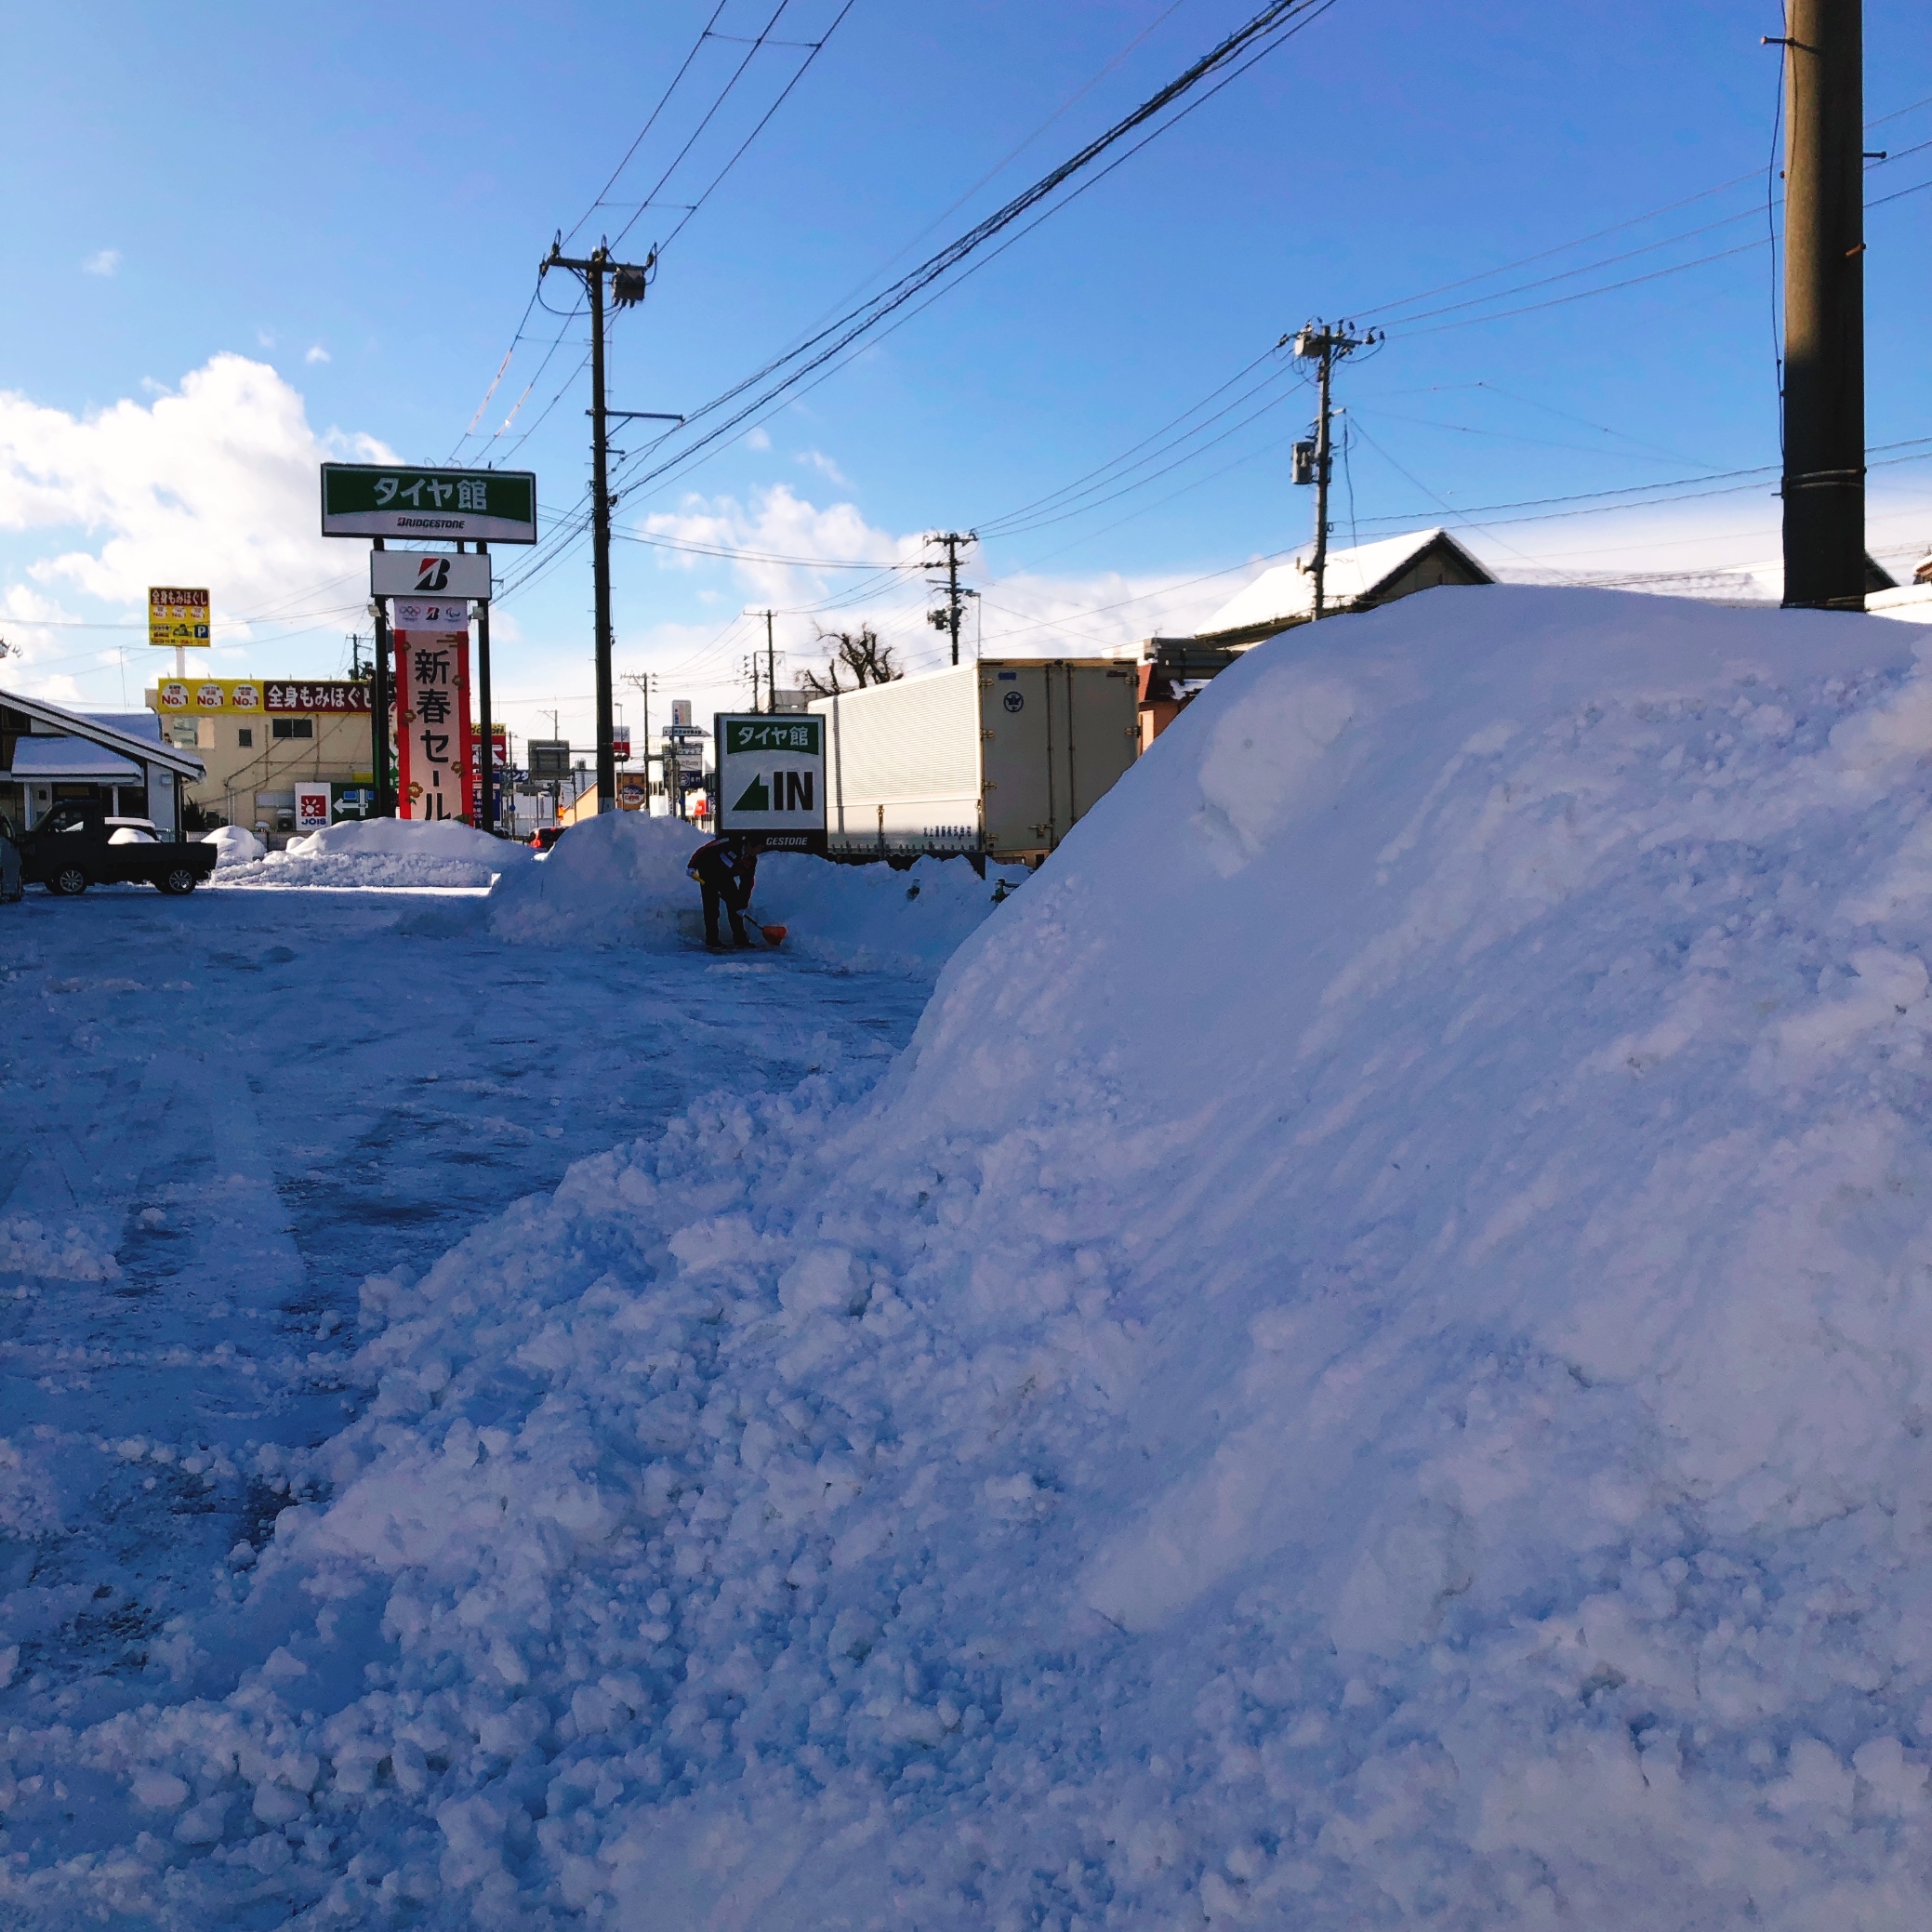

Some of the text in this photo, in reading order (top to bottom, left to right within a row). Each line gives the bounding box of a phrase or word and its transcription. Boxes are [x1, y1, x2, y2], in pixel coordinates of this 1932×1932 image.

[374, 478, 487, 509] タイヤ館
[397, 517, 465, 529] BRIDGESTONE
[197, 626, 206, 637] P
[162, 695, 188, 705] No.1
[197, 695, 224, 706] No.1
[232, 696, 258, 706] No.1
[415, 649, 452, 820] 新春セール
[738, 726, 808, 746] タイヤ館
[774, 772, 814, 810] IN
[765, 837, 808, 846] GESTONE
